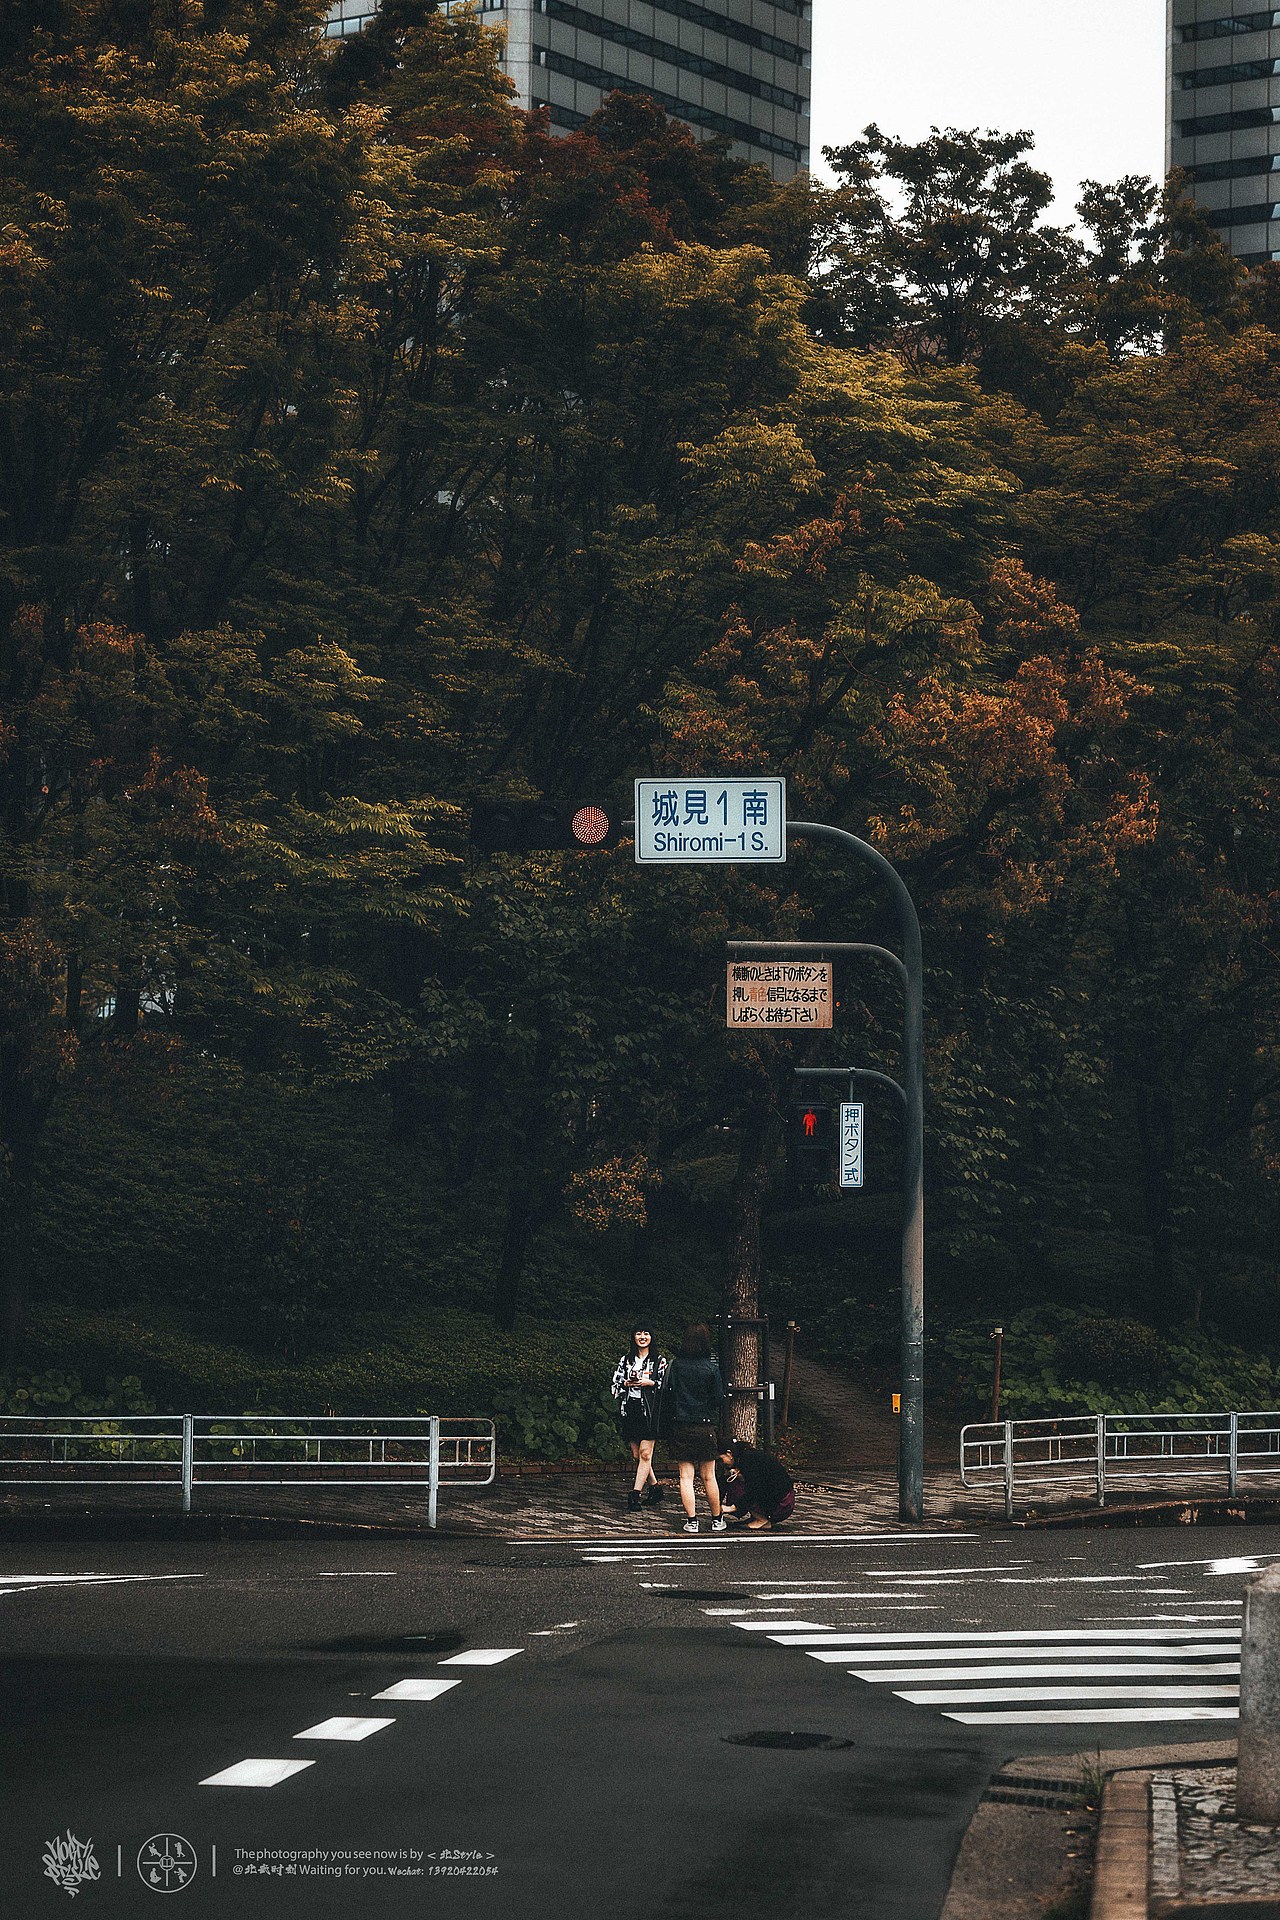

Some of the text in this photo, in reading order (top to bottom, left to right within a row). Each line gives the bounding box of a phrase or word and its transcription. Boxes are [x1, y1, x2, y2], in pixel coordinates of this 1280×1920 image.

[652, 789, 769, 827] 城見1南
[653, 831, 769, 852] Shiromi-1 S.
[731, 965, 828, 983] 横断のときは下のボタンを
[732, 986, 828, 1003] 押し青色信号になるまで
[732, 1006, 818, 1023] しばらくお待ち下さい
[844, 1107, 860, 1183] 押ボタン式
